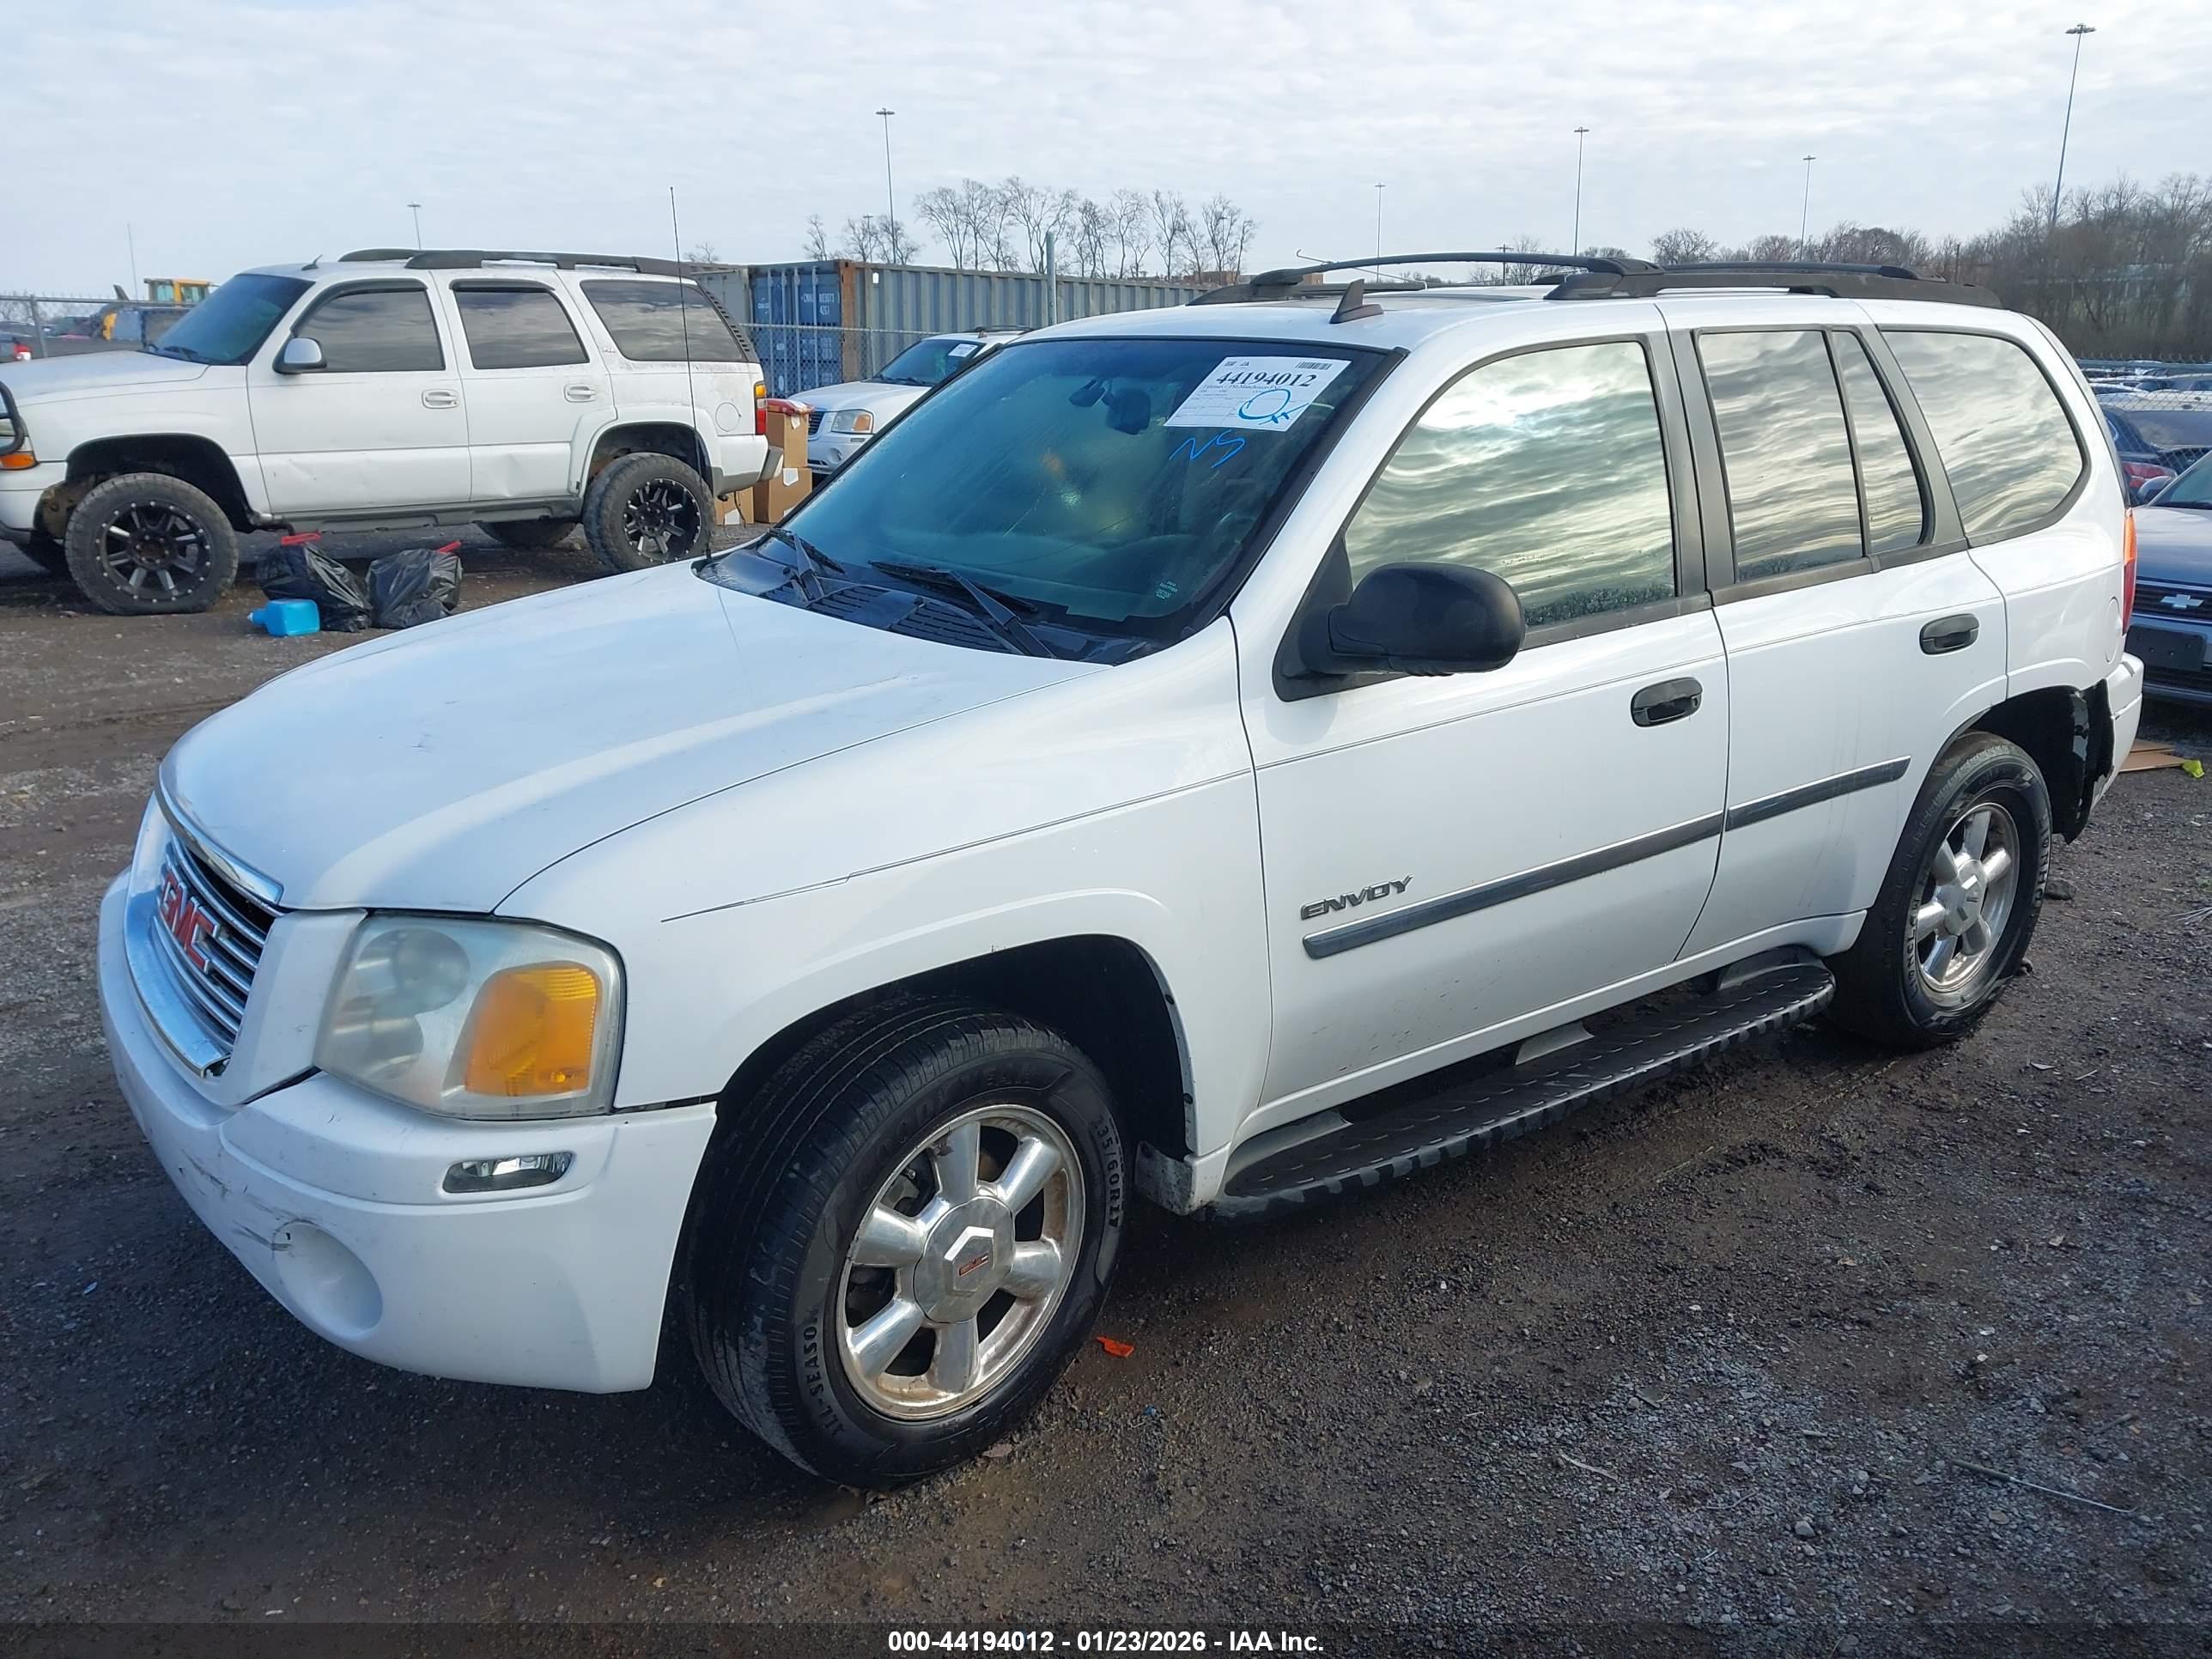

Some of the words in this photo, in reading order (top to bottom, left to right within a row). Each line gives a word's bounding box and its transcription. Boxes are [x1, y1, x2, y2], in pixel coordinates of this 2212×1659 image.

[1217, 370, 1317, 387] 44194012
[1300, 873, 1414, 921] ENVOY
[158, 870, 220, 974] GMC
